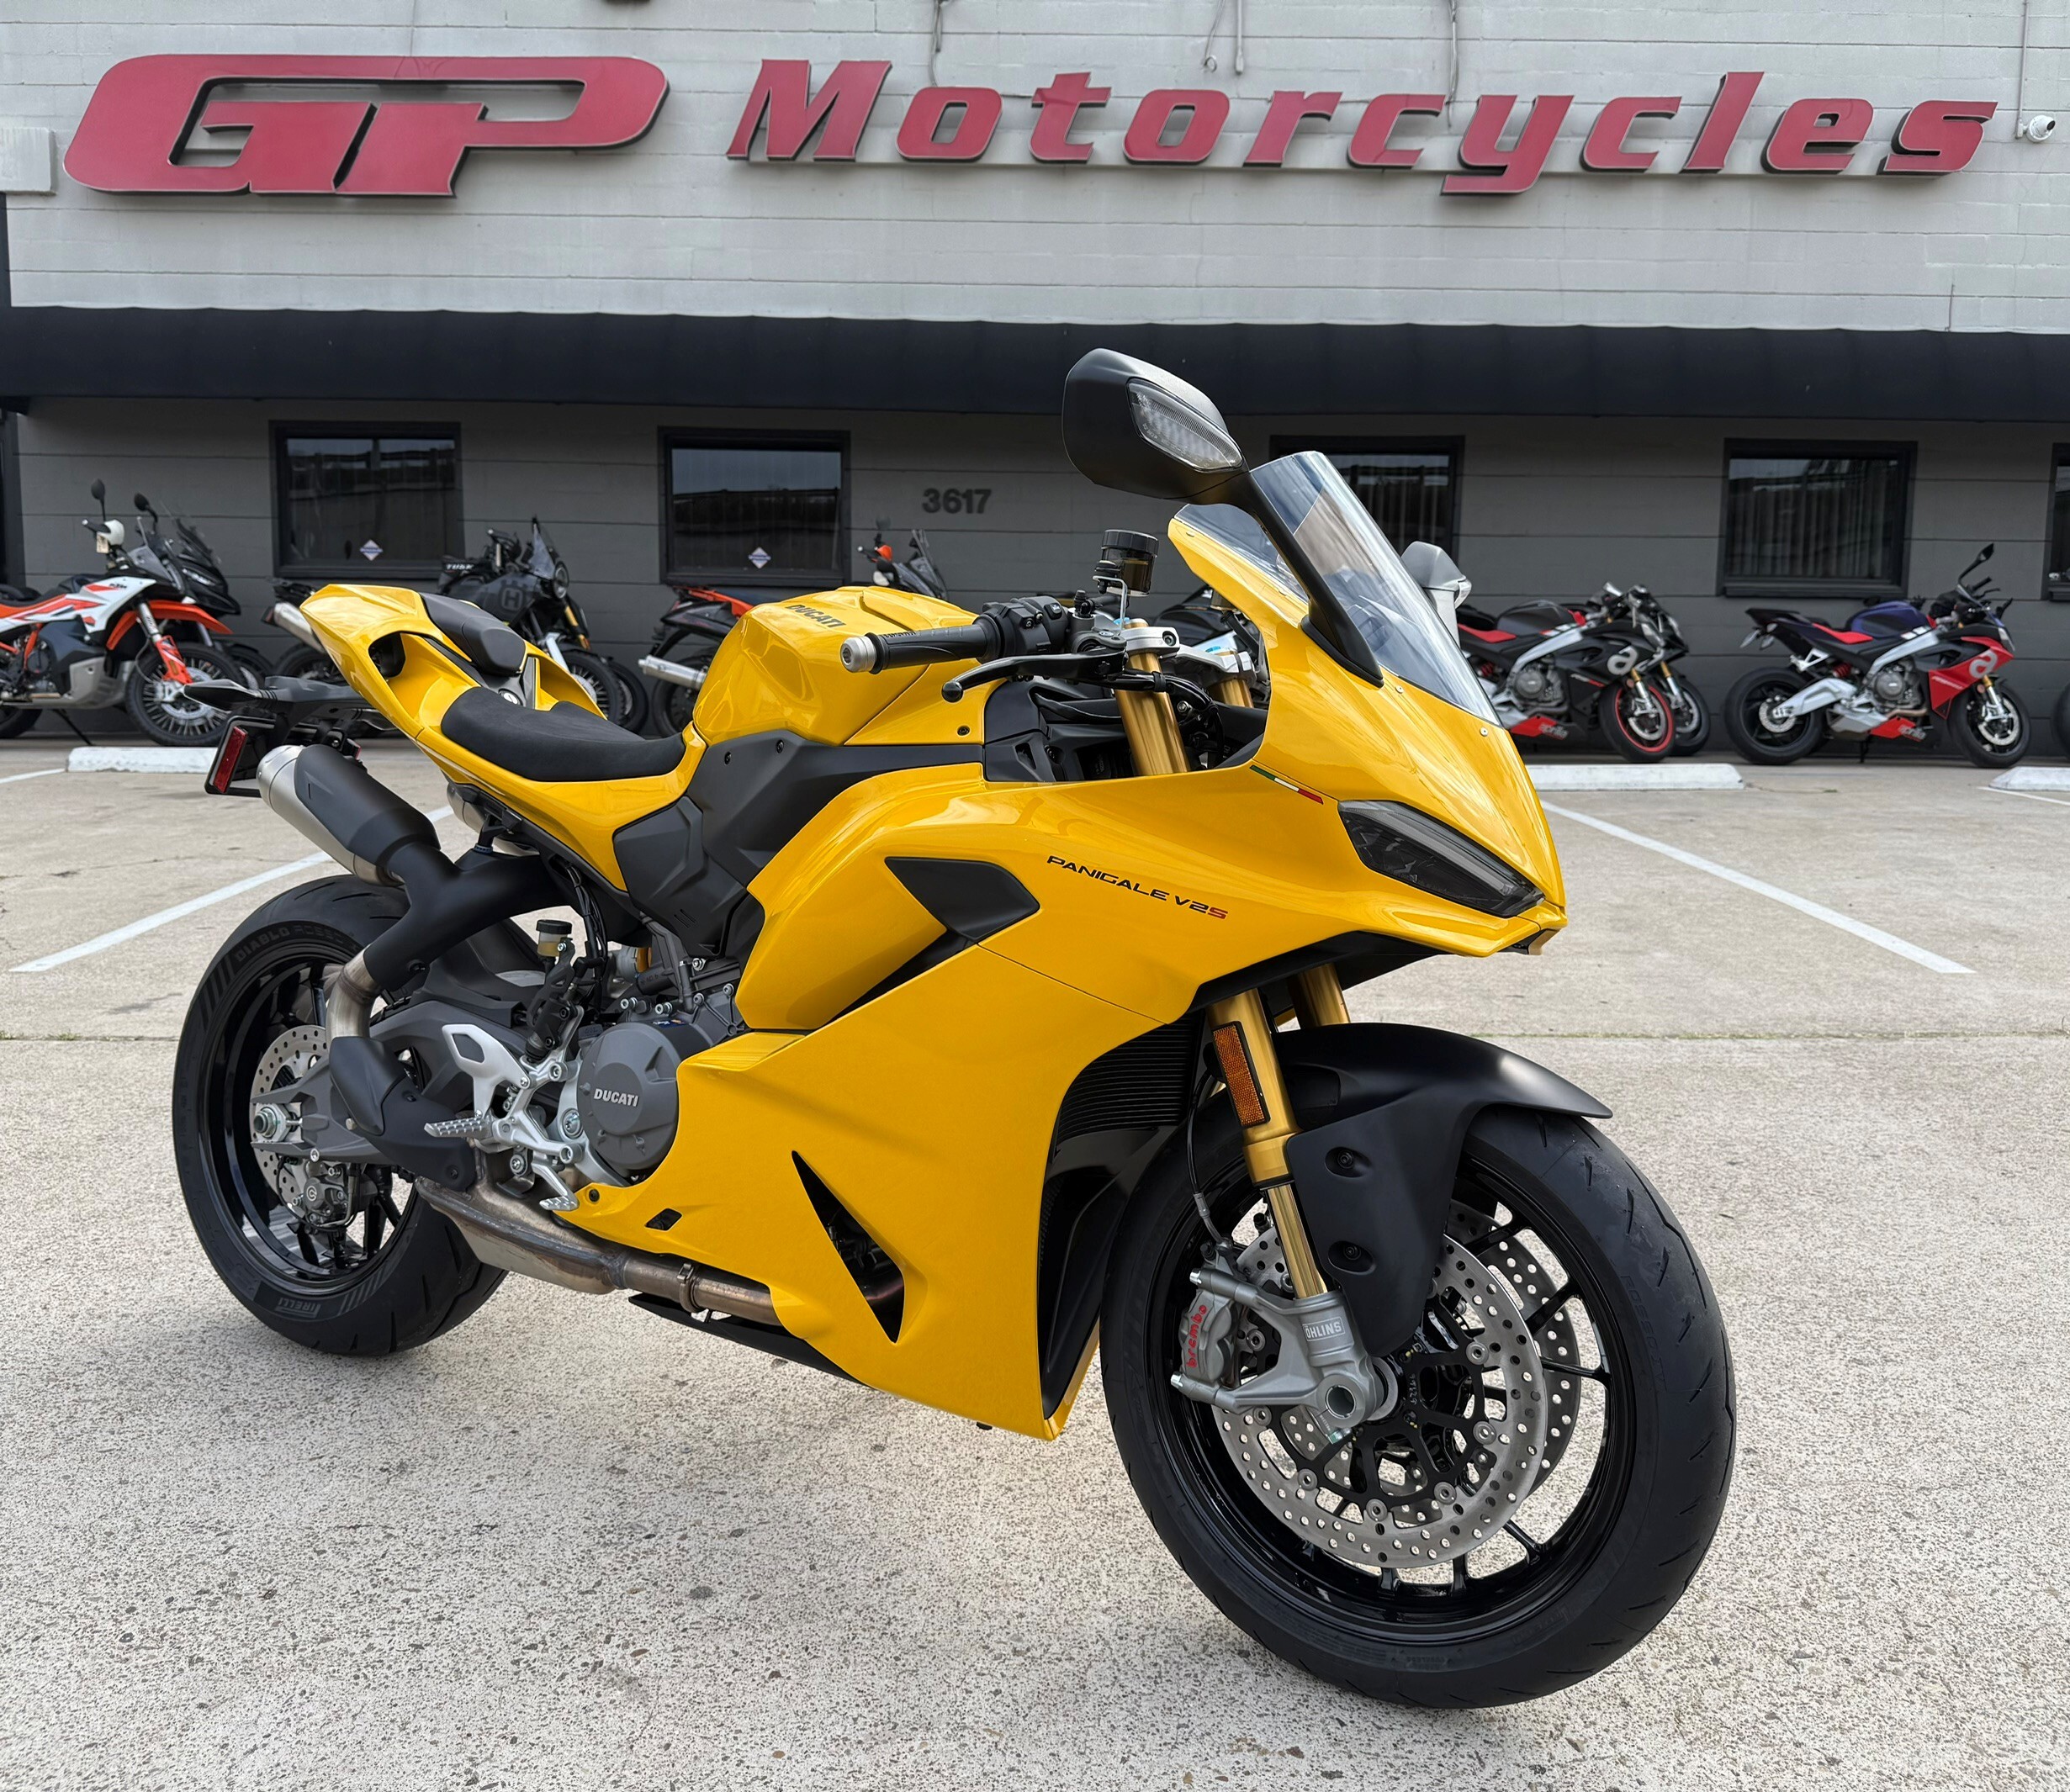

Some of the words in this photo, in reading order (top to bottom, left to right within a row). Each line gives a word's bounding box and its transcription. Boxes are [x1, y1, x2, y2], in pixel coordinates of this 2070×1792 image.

[63, 54, 670, 197] GP
[728, 60, 1998, 194] Motorcycles
[922, 488, 992, 514] 3617
[784, 604, 846, 628] DUCATI
[1046, 854, 1170, 901] PANIGALE
[1174, 895, 1229, 920] V2S
[234, 927, 290, 962] DIABLO
[593, 1088, 639, 1107] DUCATI
[273, 1296, 322, 1319] PIRELLI
[1186, 1305, 1207, 1368] brembo
[1305, 1319, 1343, 1339] ÖHLINS
